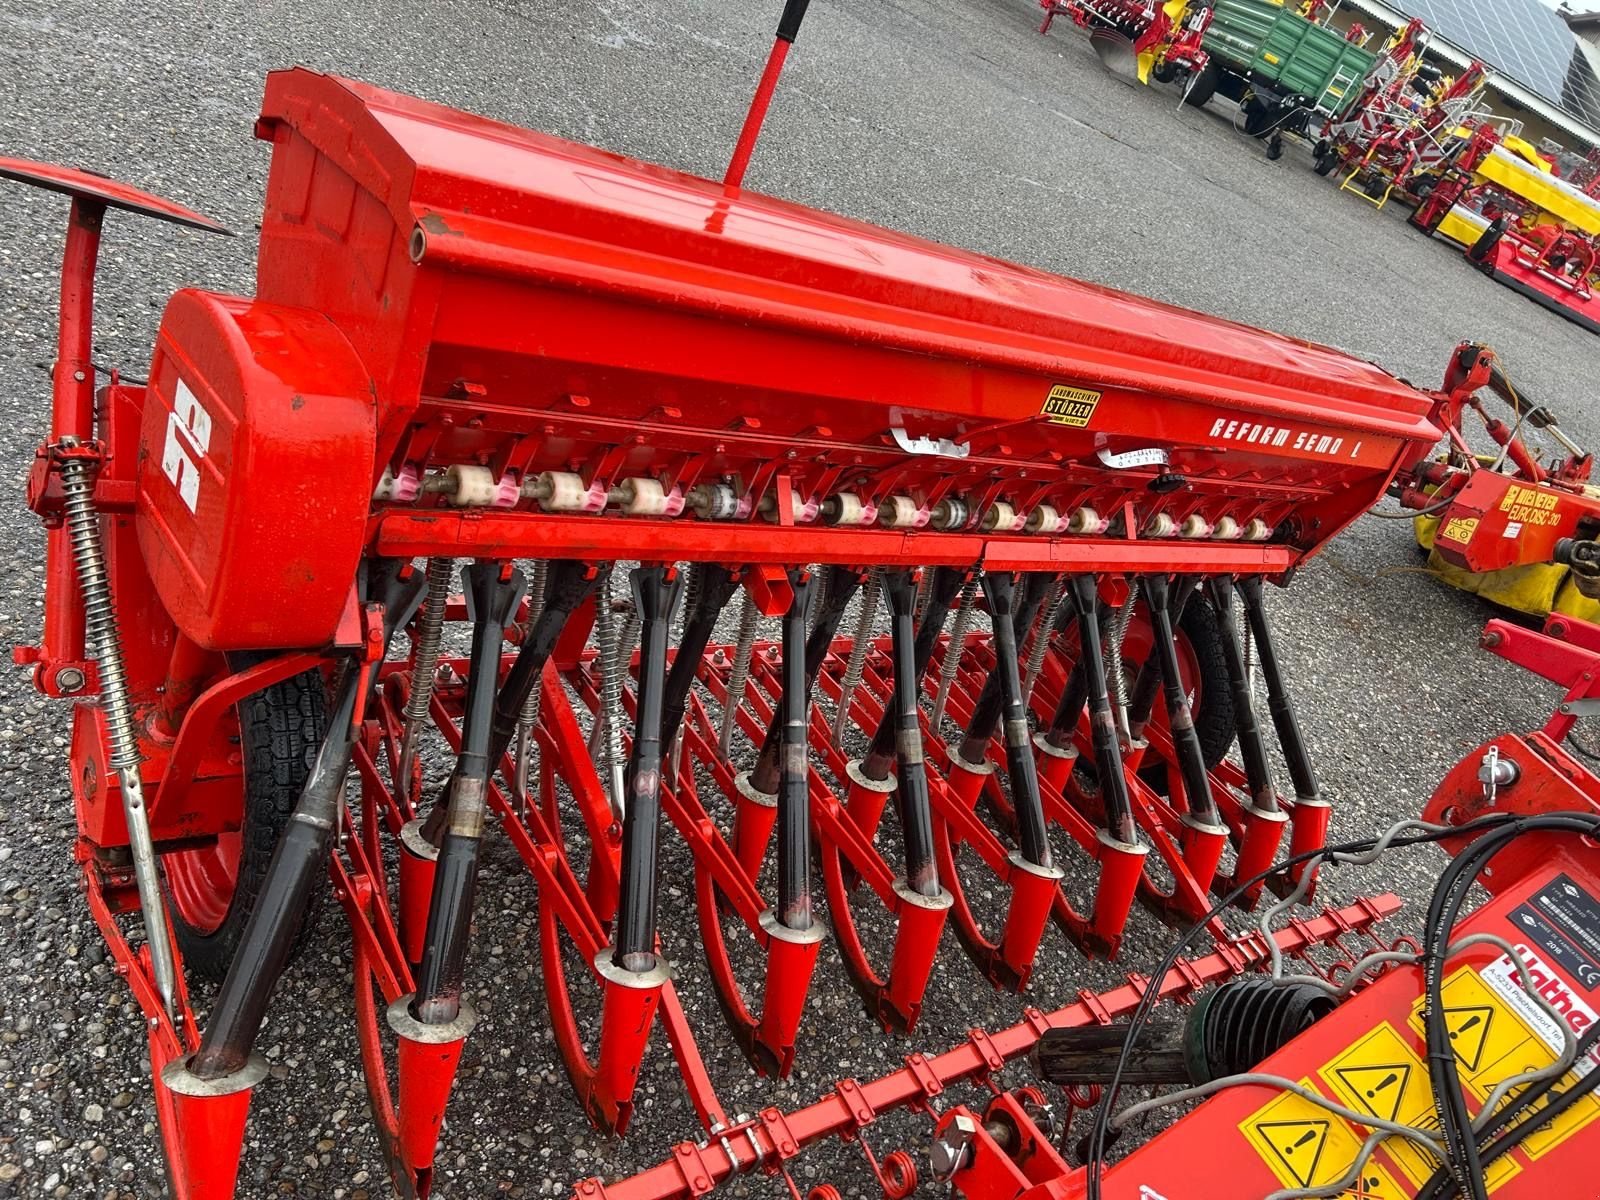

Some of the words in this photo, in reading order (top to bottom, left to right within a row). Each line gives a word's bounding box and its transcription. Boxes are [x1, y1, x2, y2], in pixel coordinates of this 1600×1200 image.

[1208, 417, 1291, 447] REFORM
[1293, 432, 1343, 455] SEMO
[1350, 441, 1362, 458] L
[1547, 512, 1562, 526] 310
